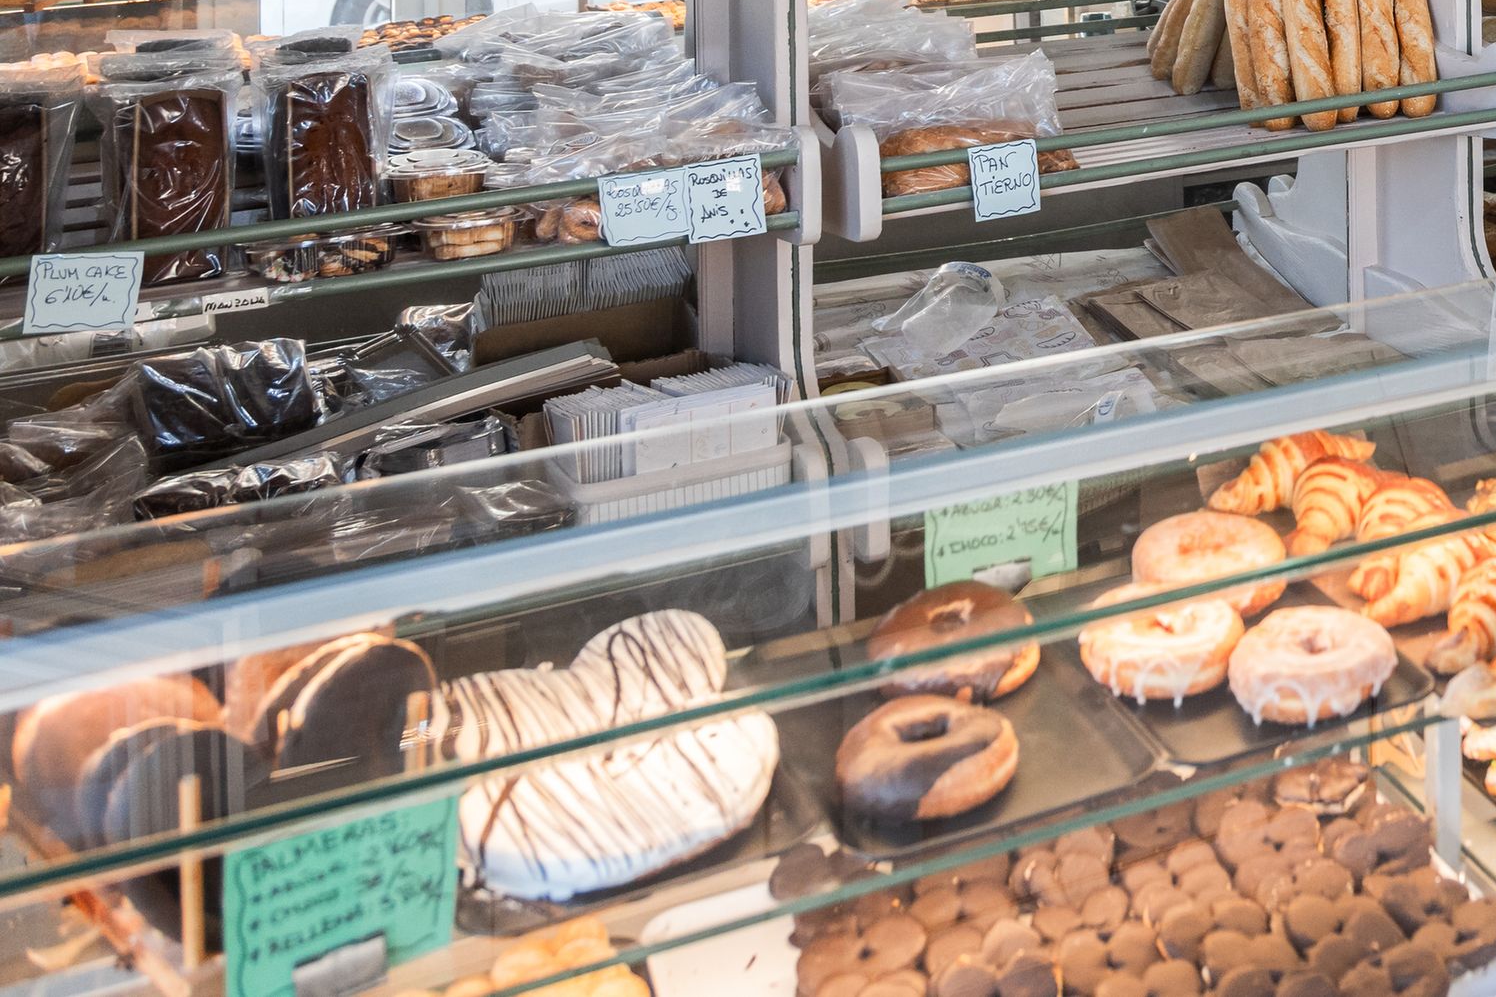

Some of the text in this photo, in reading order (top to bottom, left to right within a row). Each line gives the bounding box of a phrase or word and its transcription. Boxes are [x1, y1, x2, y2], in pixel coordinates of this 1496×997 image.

[974, 151, 1016, 173] PAN
[712, 189, 728, 199] DE
[39, 260, 128, 280] PLUM CAKE
